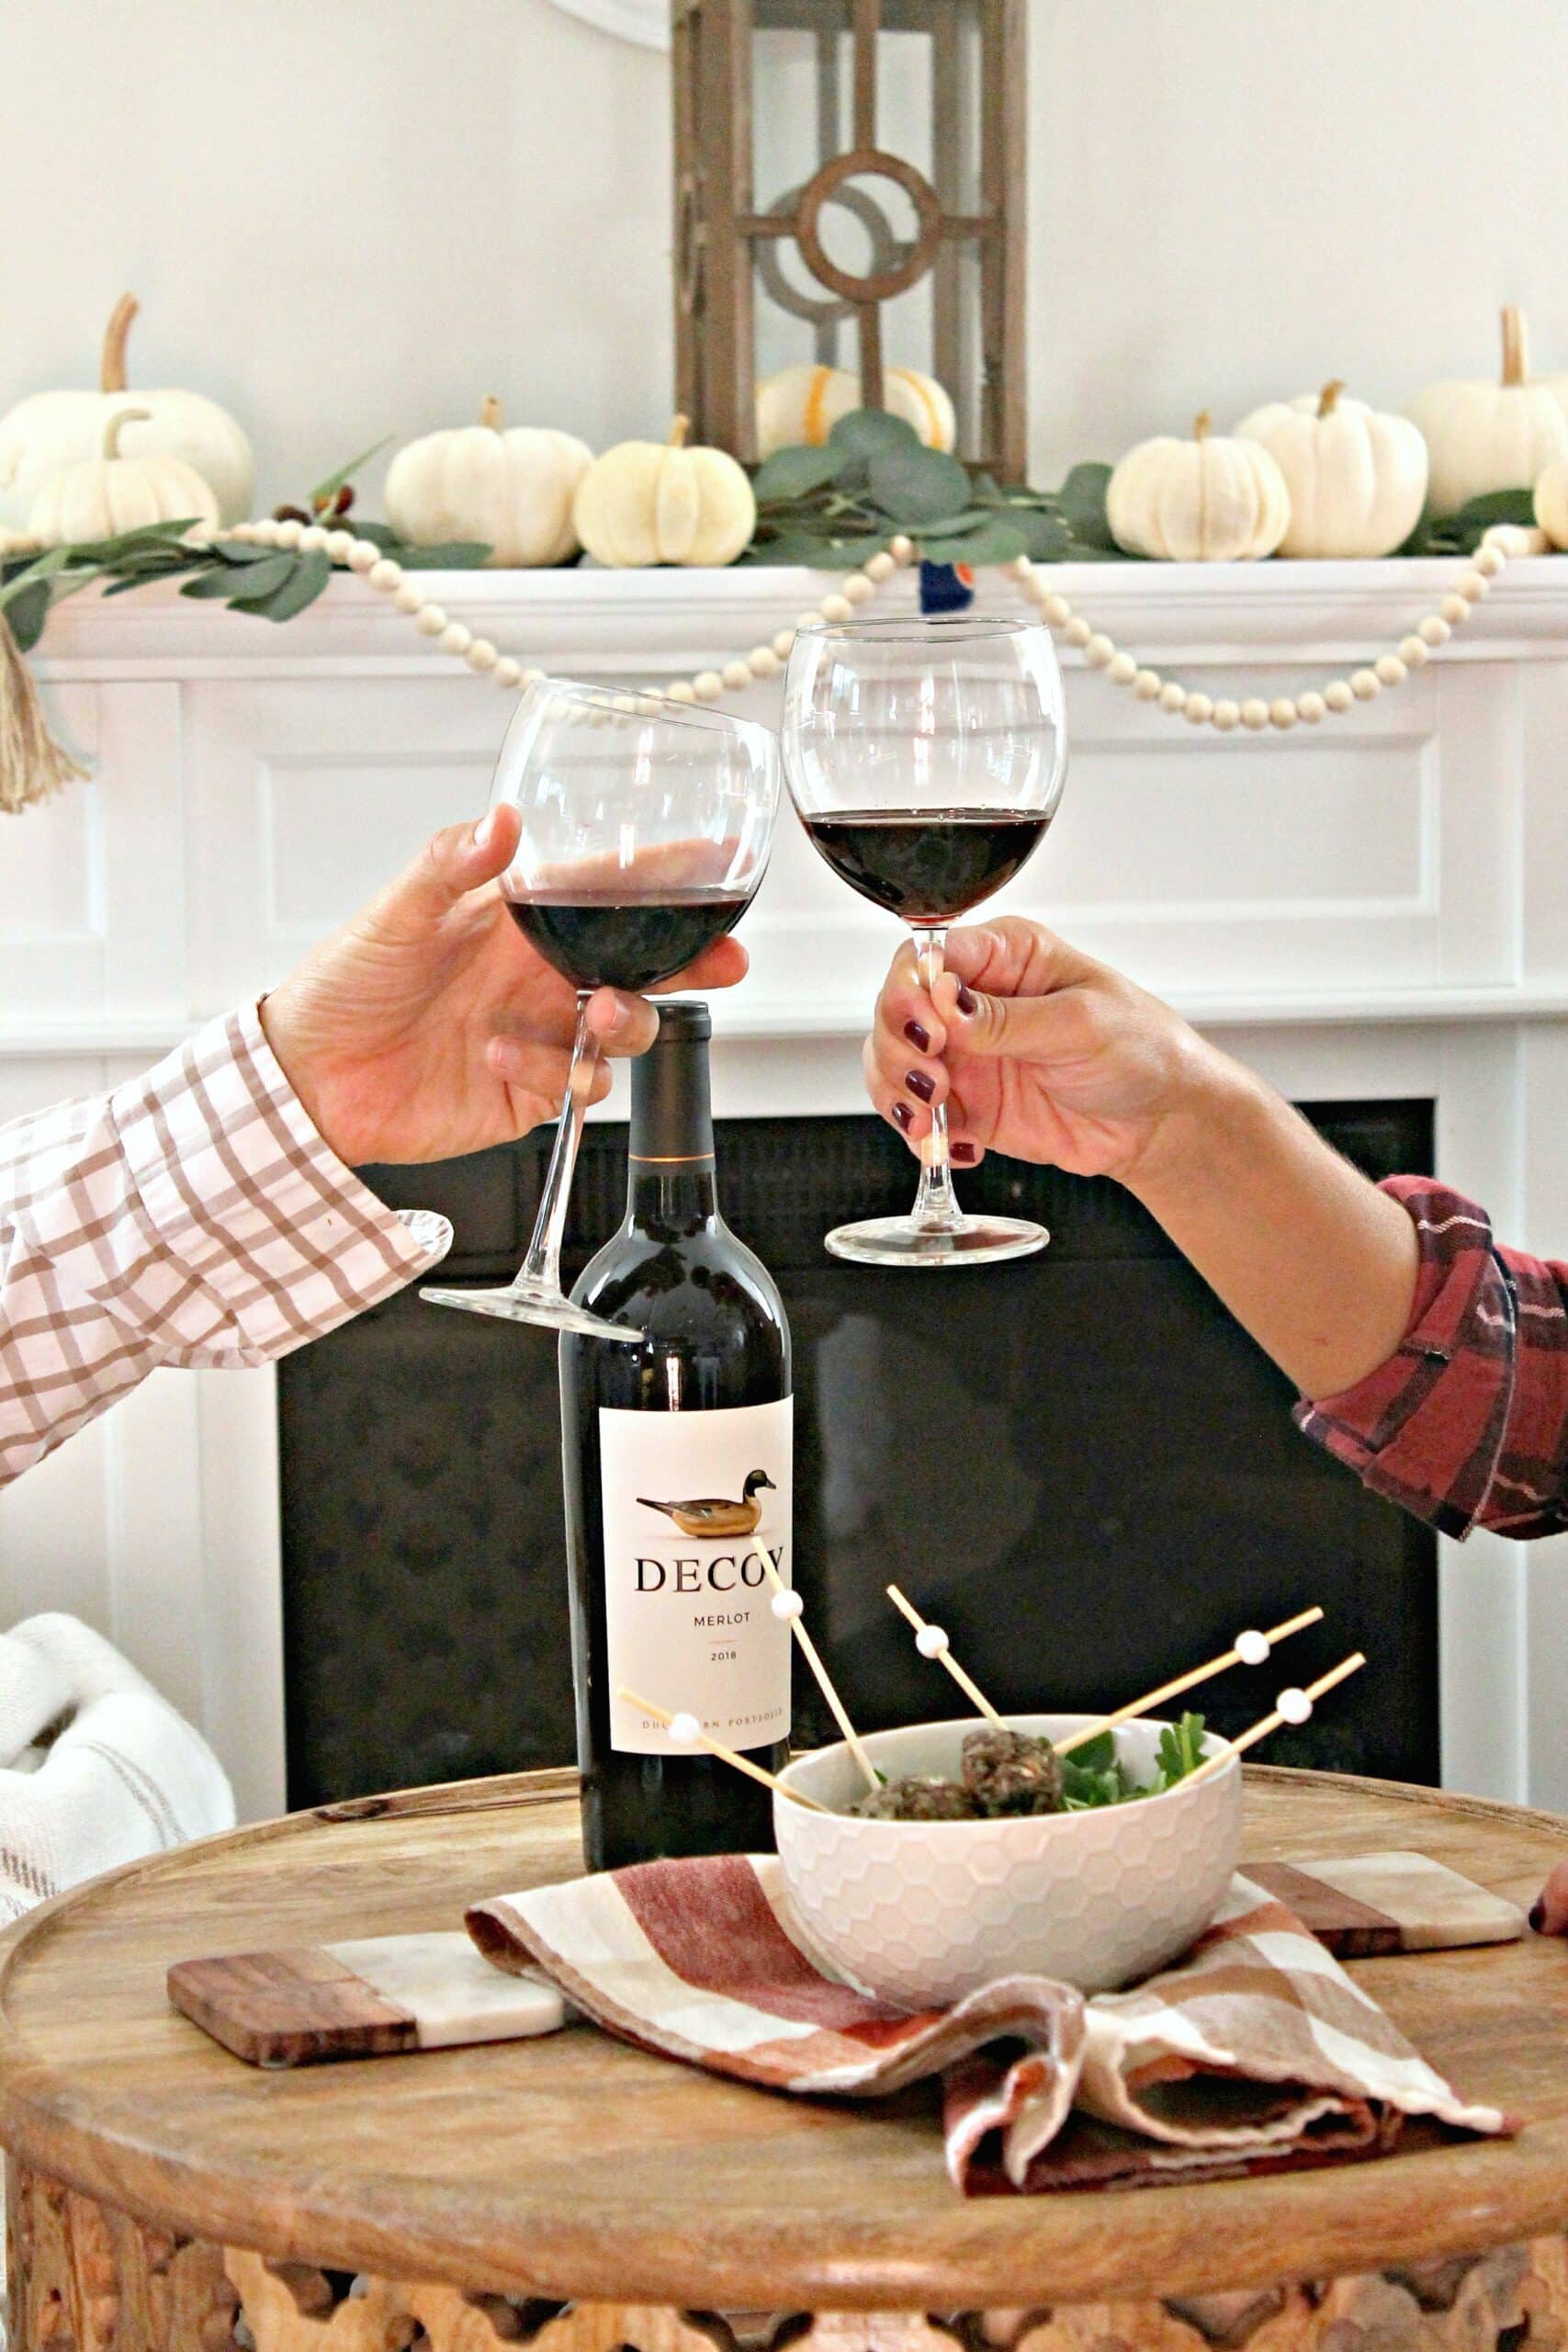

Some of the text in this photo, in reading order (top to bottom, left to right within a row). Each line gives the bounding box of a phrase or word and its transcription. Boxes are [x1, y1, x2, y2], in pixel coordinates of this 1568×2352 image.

[635, 1547, 784, 1592] DECOY
[694, 1612, 750, 1627] MERLOT
[711, 1651, 737, 1662] 2018
[642, 1720, 720, 1730] DUCRN
